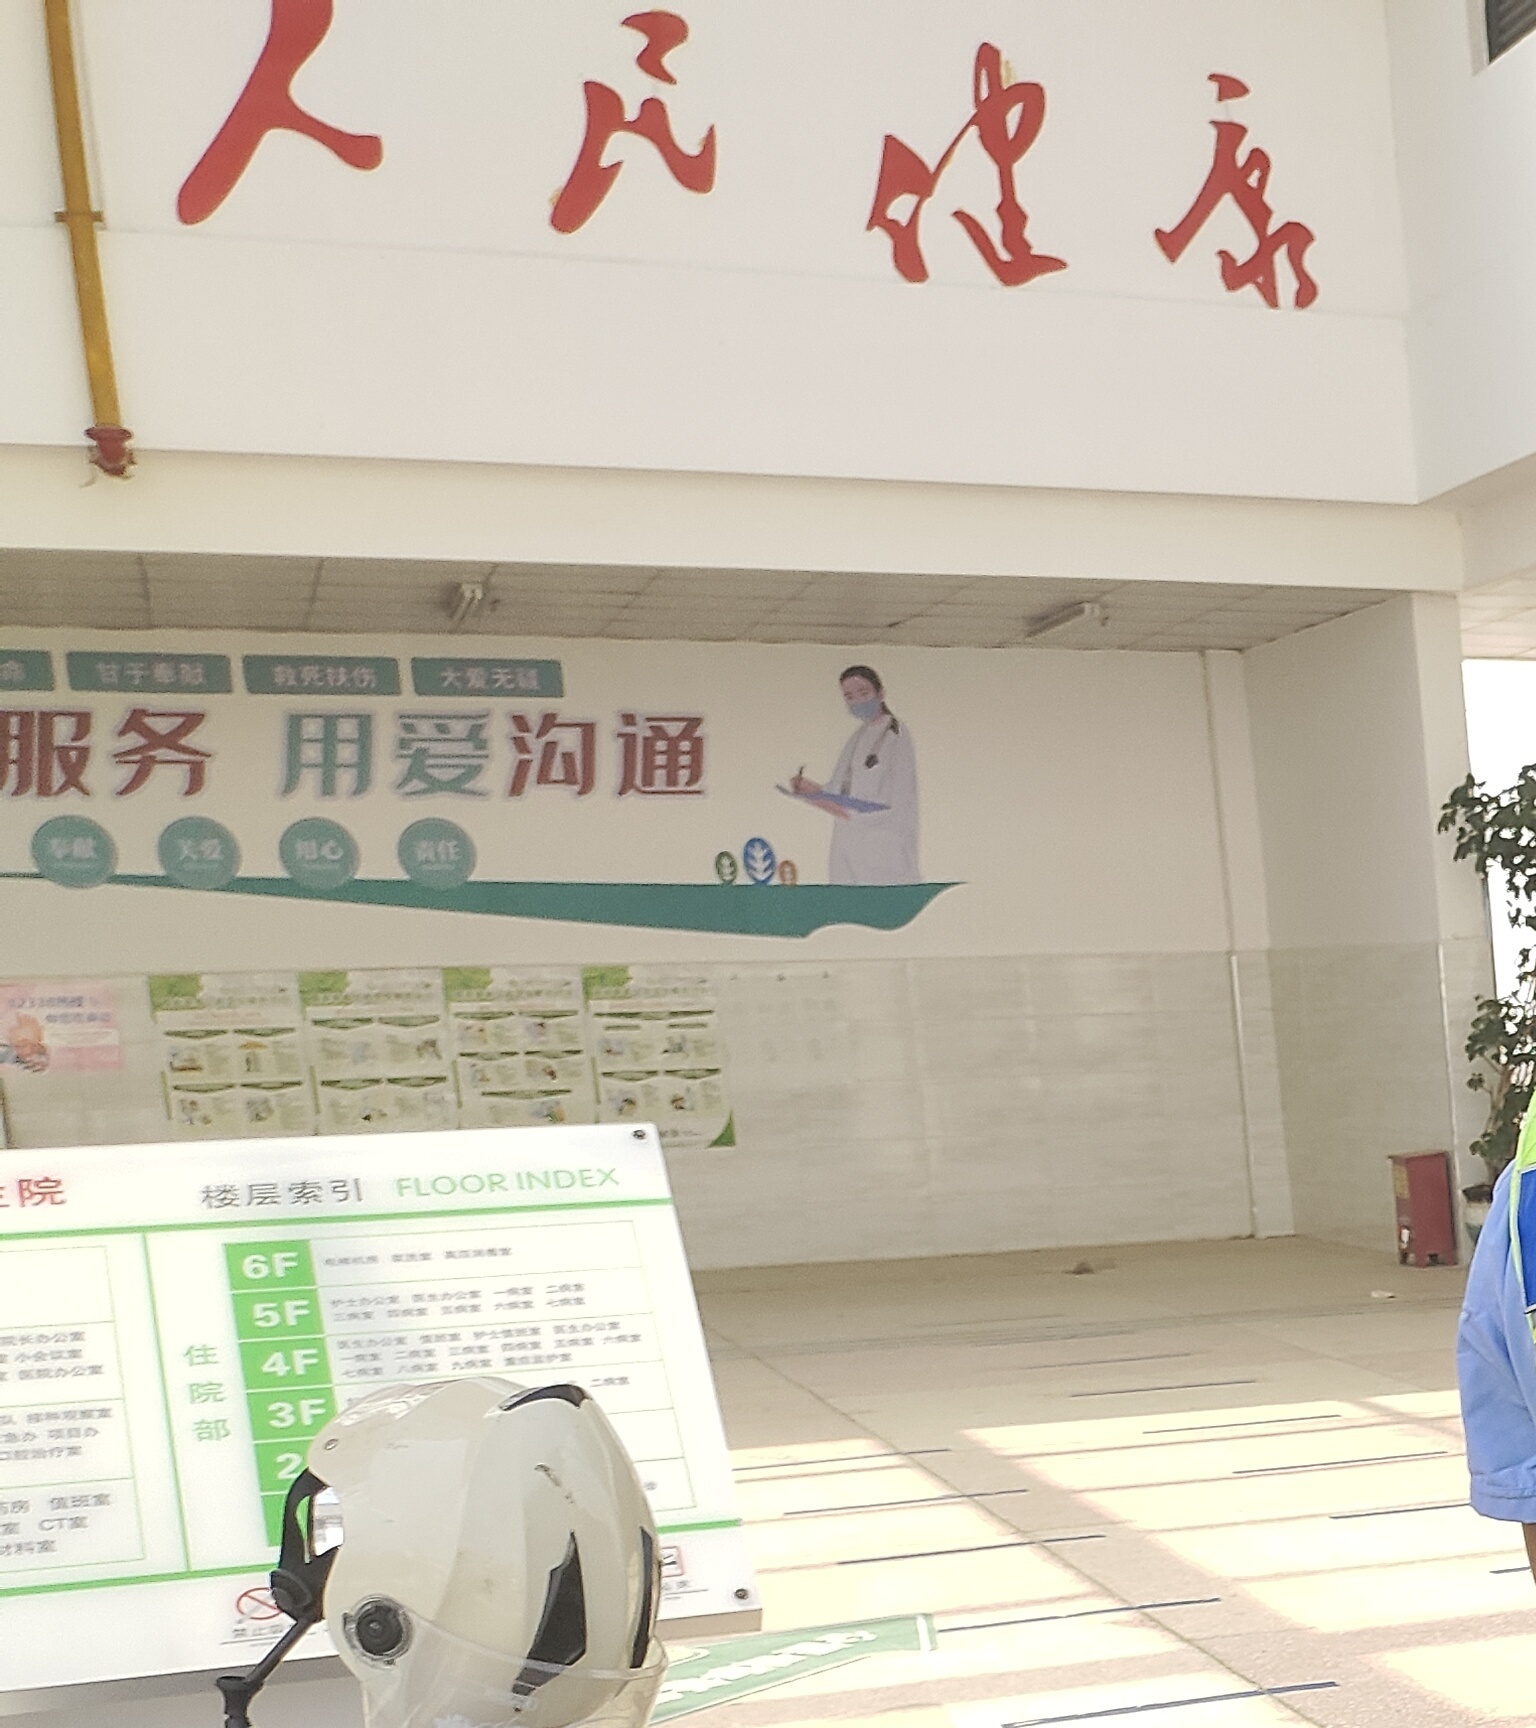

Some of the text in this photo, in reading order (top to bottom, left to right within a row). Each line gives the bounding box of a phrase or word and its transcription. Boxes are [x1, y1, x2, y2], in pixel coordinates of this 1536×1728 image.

[176, 0, 1319, 311] 人民健康
[95, 662, 207, 687] 甘于奉献
[273, 665, 377, 689] 救死扶伤
[440, 668, 541, 691] 大爱无疆
[0, 708, 707, 799] 服务 用爱沟通
[415, 840, 460, 863] 责任
[0, 1176, 67, 1207] 院
[200, 1177, 364, 1210] 楼层索引
[396, 1166, 621, 1198] FLOOR INDEX
[242, 1252, 299, 1280] 6F
[252, 1300, 311, 1329] 5F
[261, 1347, 320, 1378] 4F
[184, 1343, 232, 1443] 住院部
[267, 1399, 326, 1429] 3F
[276, 1453, 304, 1481] 2
